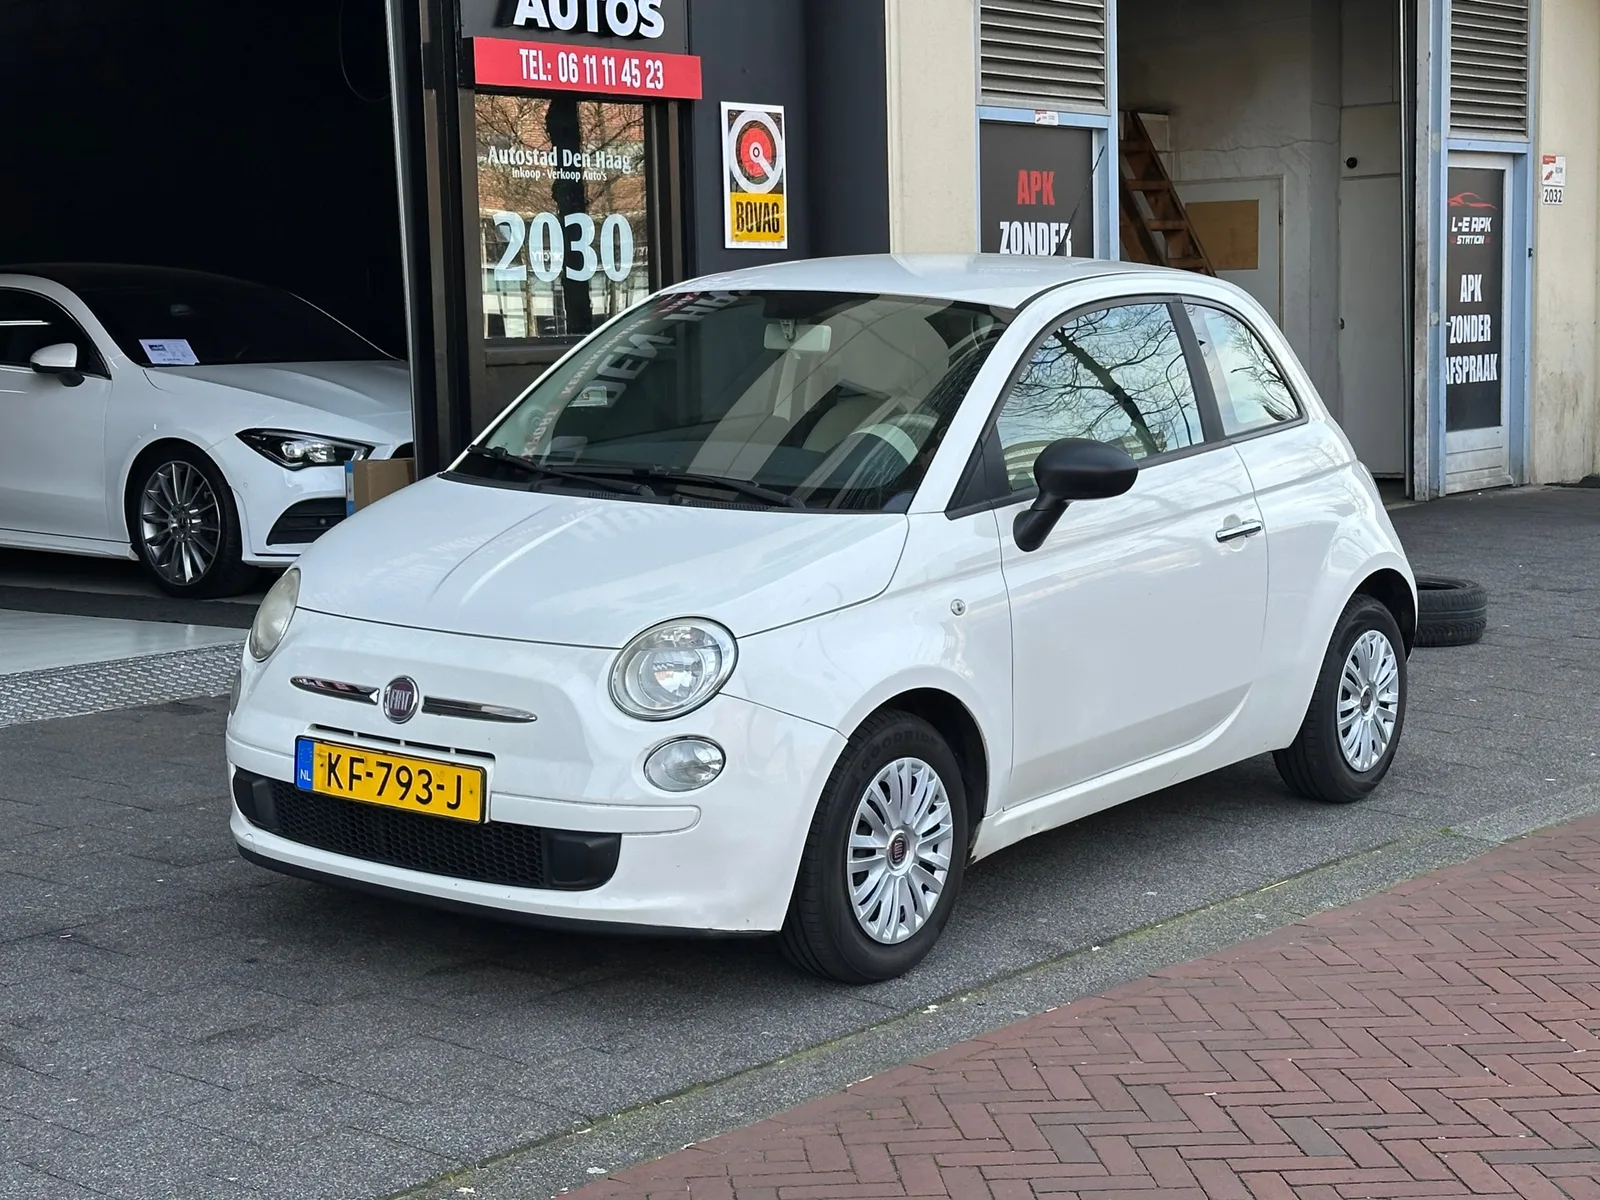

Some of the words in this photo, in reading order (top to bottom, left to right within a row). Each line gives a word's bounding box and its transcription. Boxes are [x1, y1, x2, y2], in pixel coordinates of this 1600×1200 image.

[519, 48, 553, 82] TEL:
[557, 51, 579, 84] 06
[583, 54, 598, 85] 11
[602, 55, 616, 86] 11
[620, 57, 641, 88] 45
[645, 59, 665, 90] 23
[487, 145, 558, 168] Autostad
[562, 149, 592, 168] Den
[595, 150, 632, 175] Haag
[511, 167, 541, 181] Inkoop
[547, 169, 581, 183] Verkoop
[582, 171, 608, 182] Auto's
[1016, 169, 1056, 206] APK
[1543, 188, 1563, 203] 2032
[735, 201, 780, 234] BOVAG
[1451, 216, 1471, 233] L-E
[1470, 216, 1492, 233] APK
[492, 211, 634, 283] 2030
[1456, 234, 1485, 245] STATION
[1460, 273, 1483, 303] APK
[1449, 313, 1492, 344] ZONDER
[390, 688, 411, 711] FIAT
[300, 769, 311, 782] NL
[326, 751, 463, 811] KF-793-J
